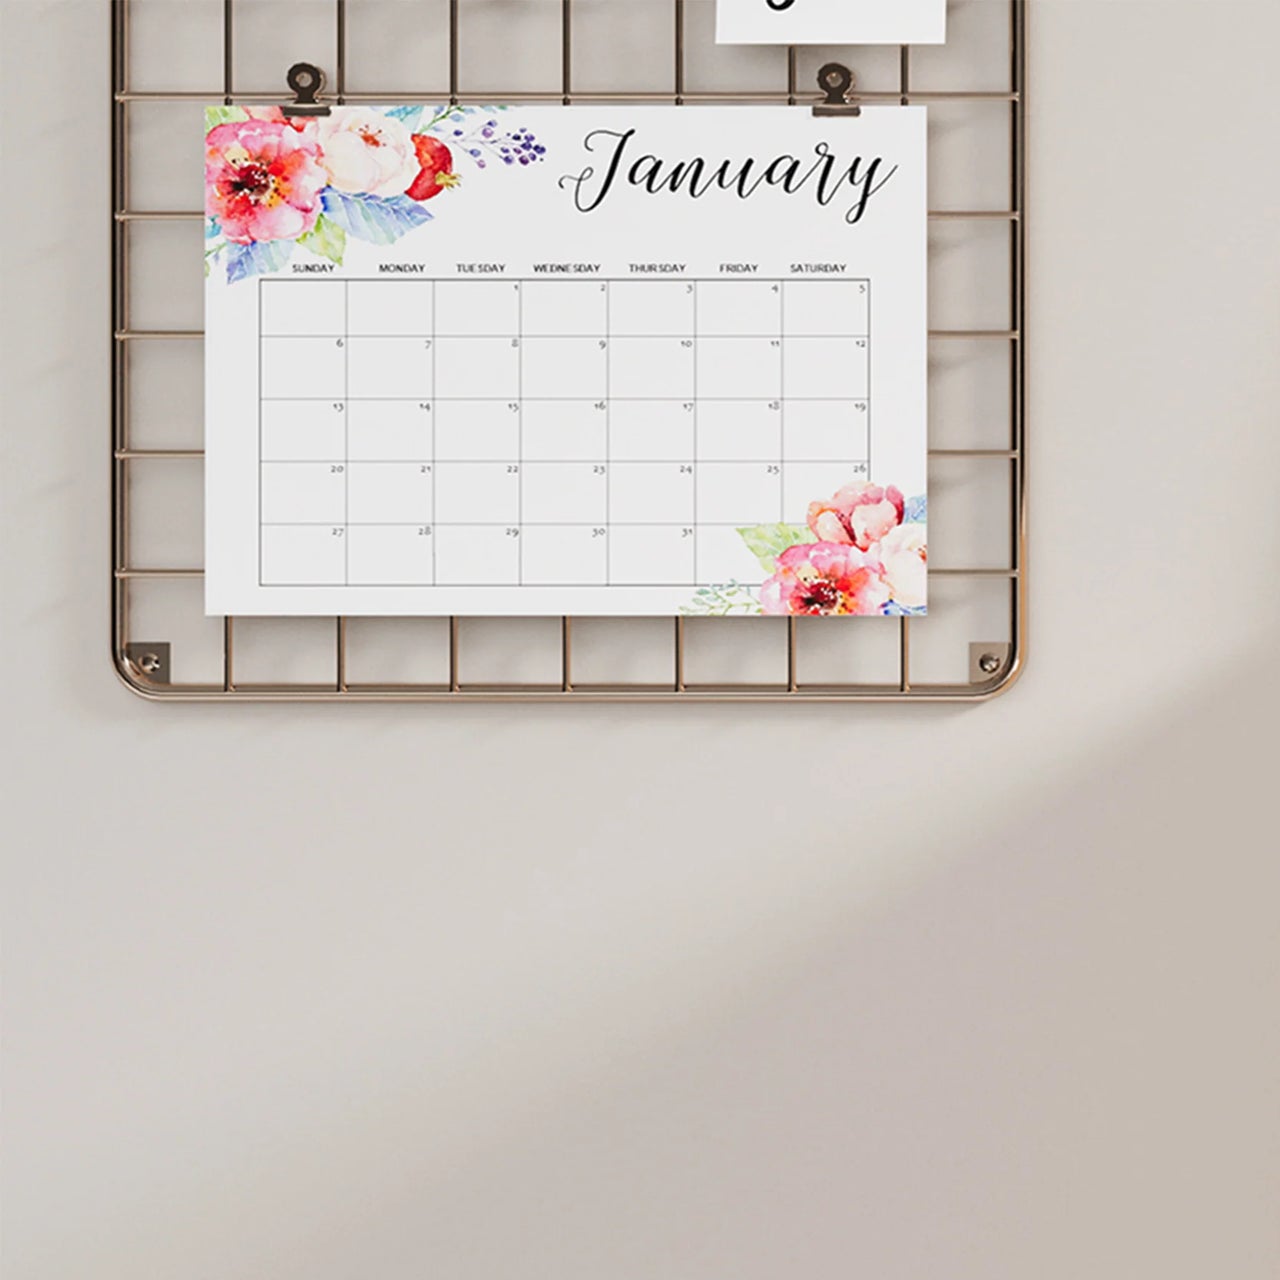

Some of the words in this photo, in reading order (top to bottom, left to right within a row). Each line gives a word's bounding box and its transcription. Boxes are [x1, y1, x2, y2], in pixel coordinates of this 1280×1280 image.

[558, 128, 898, 225] January
[292, 263, 335, 274] SUNDAY
[378, 263, 426, 274] MONDAY
[456, 263, 506, 274] TUESDAY
[532, 263, 602, 274] WEDNESDAY
[629, 263, 687, 274] THURSDAY
[719, 263, 759, 274] FRIDAY
[790, 263, 847, 274] SATURDAY
[680, 339, 693, 348] 10
[855, 339, 866, 348] 12
[332, 402, 345, 413] 13
[419, 402, 431, 412] 14
[507, 402, 518, 413] 15
[594, 400, 607, 411] 16
[682, 402, 694, 412] 17
[767, 400, 780, 411] 18
[854, 402, 867, 412] 19
[330, 465, 345, 474] 20
[420, 465, 432, 474] 21
[506, 465, 518, 474] 22
[593, 465, 606, 476] 23
[679, 465, 693, 475] 24
[766, 465, 780, 475] 25
[853, 463, 867, 474] 26
[331, 527, 345, 537] 27
[418, 525, 432, 536] 28
[505, 527, 518, 538] 29
[592, 527, 606, 538] 30
[681, 527, 693, 538] 31
